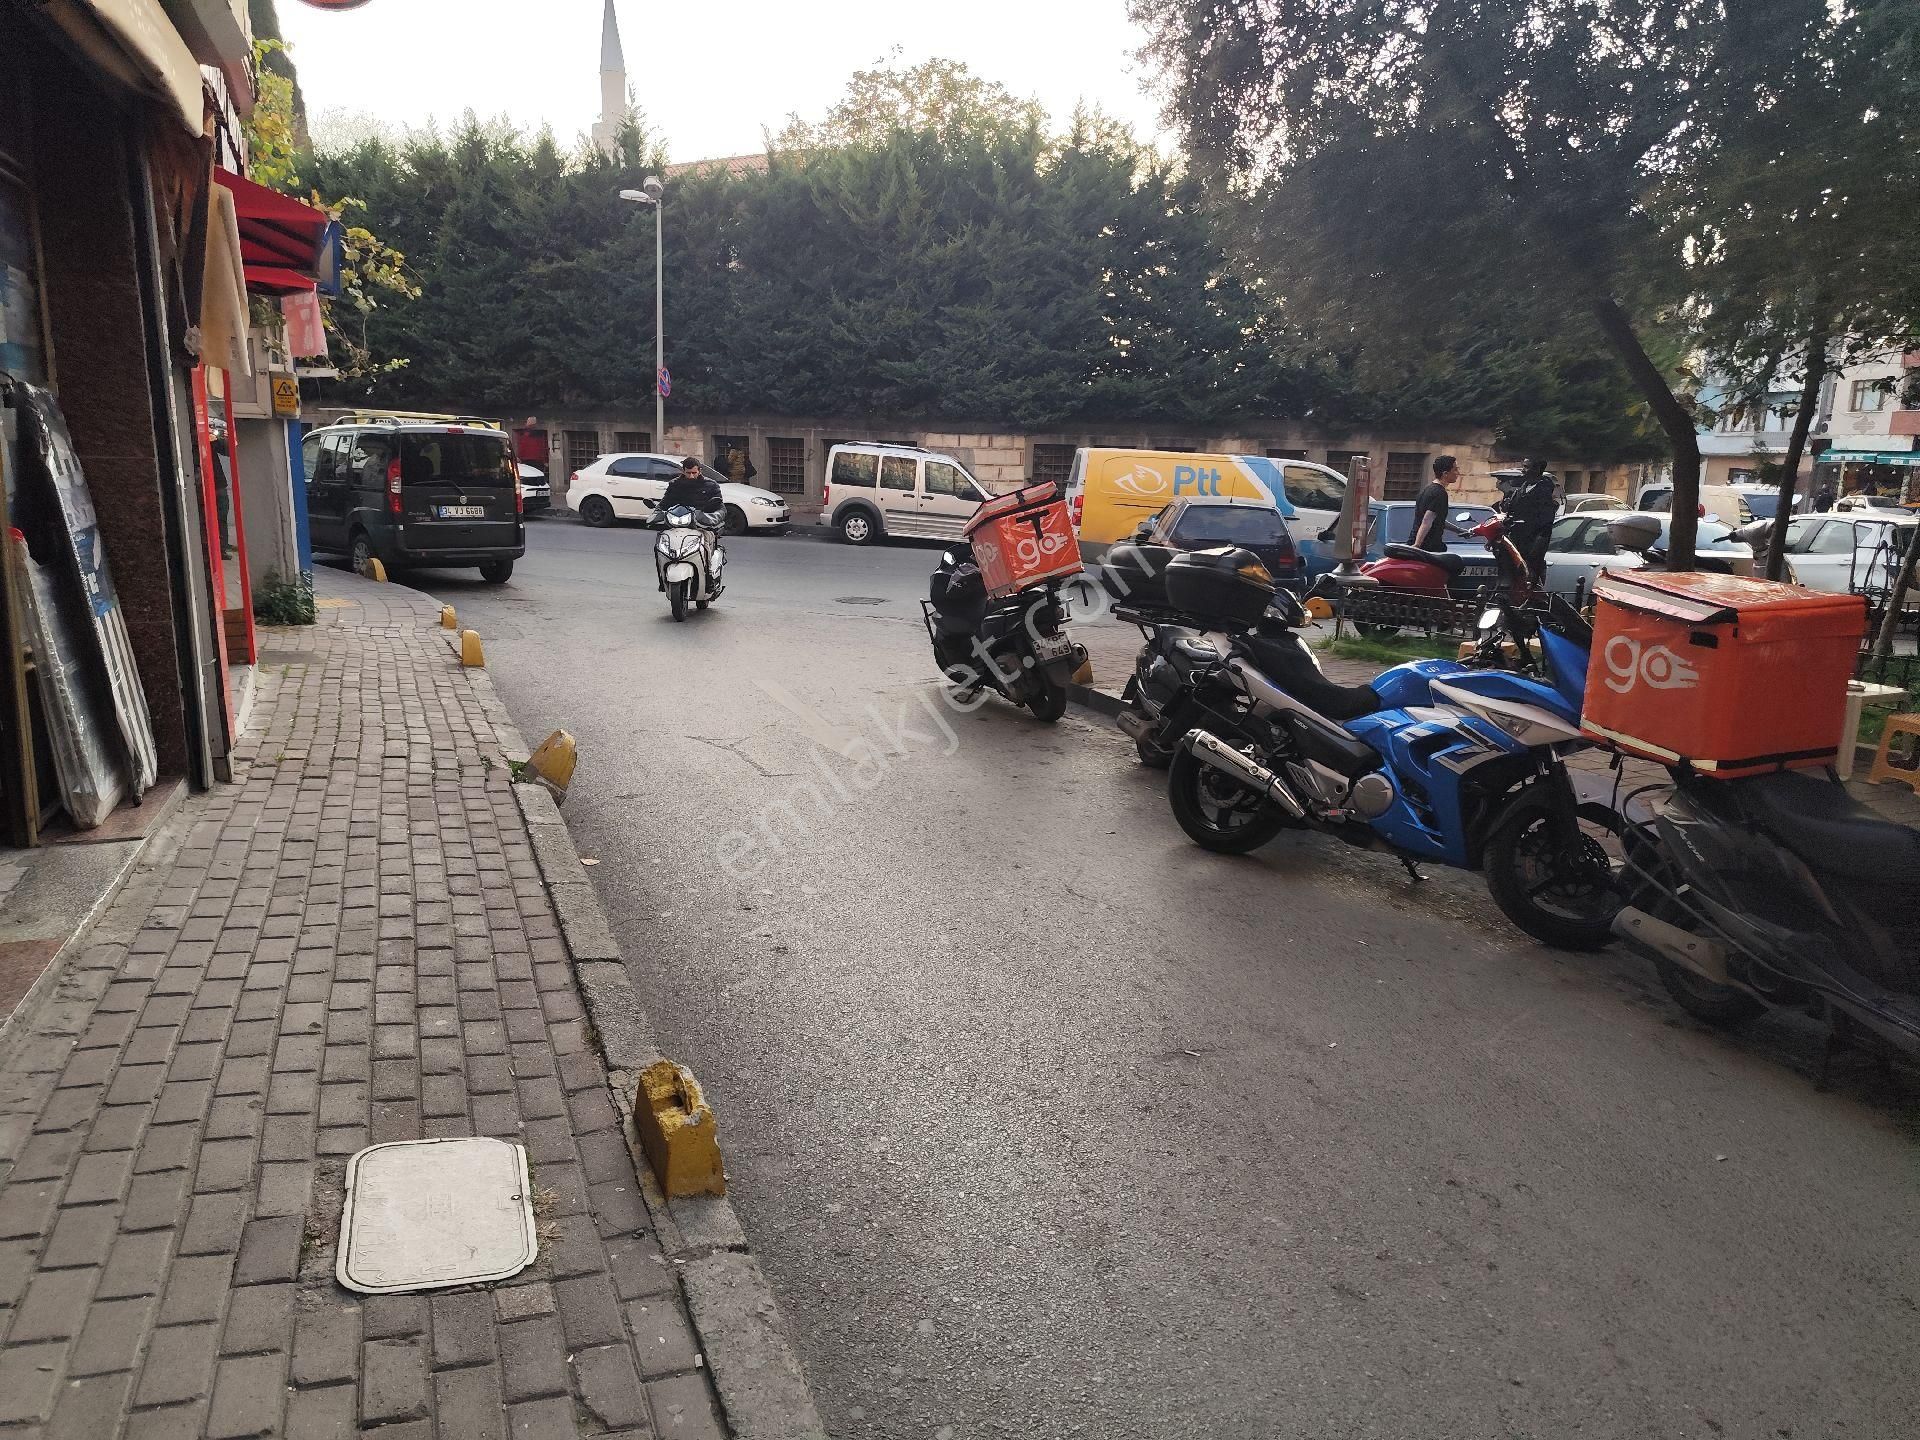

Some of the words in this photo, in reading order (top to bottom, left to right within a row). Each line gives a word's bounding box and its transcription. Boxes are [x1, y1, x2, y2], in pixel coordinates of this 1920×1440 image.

[1173, 465, 1222, 496] Ptt
[1017, 532, 1069, 569] go
[1052, 645, 1069, 656] 649
[1605, 636, 1699, 693] go
